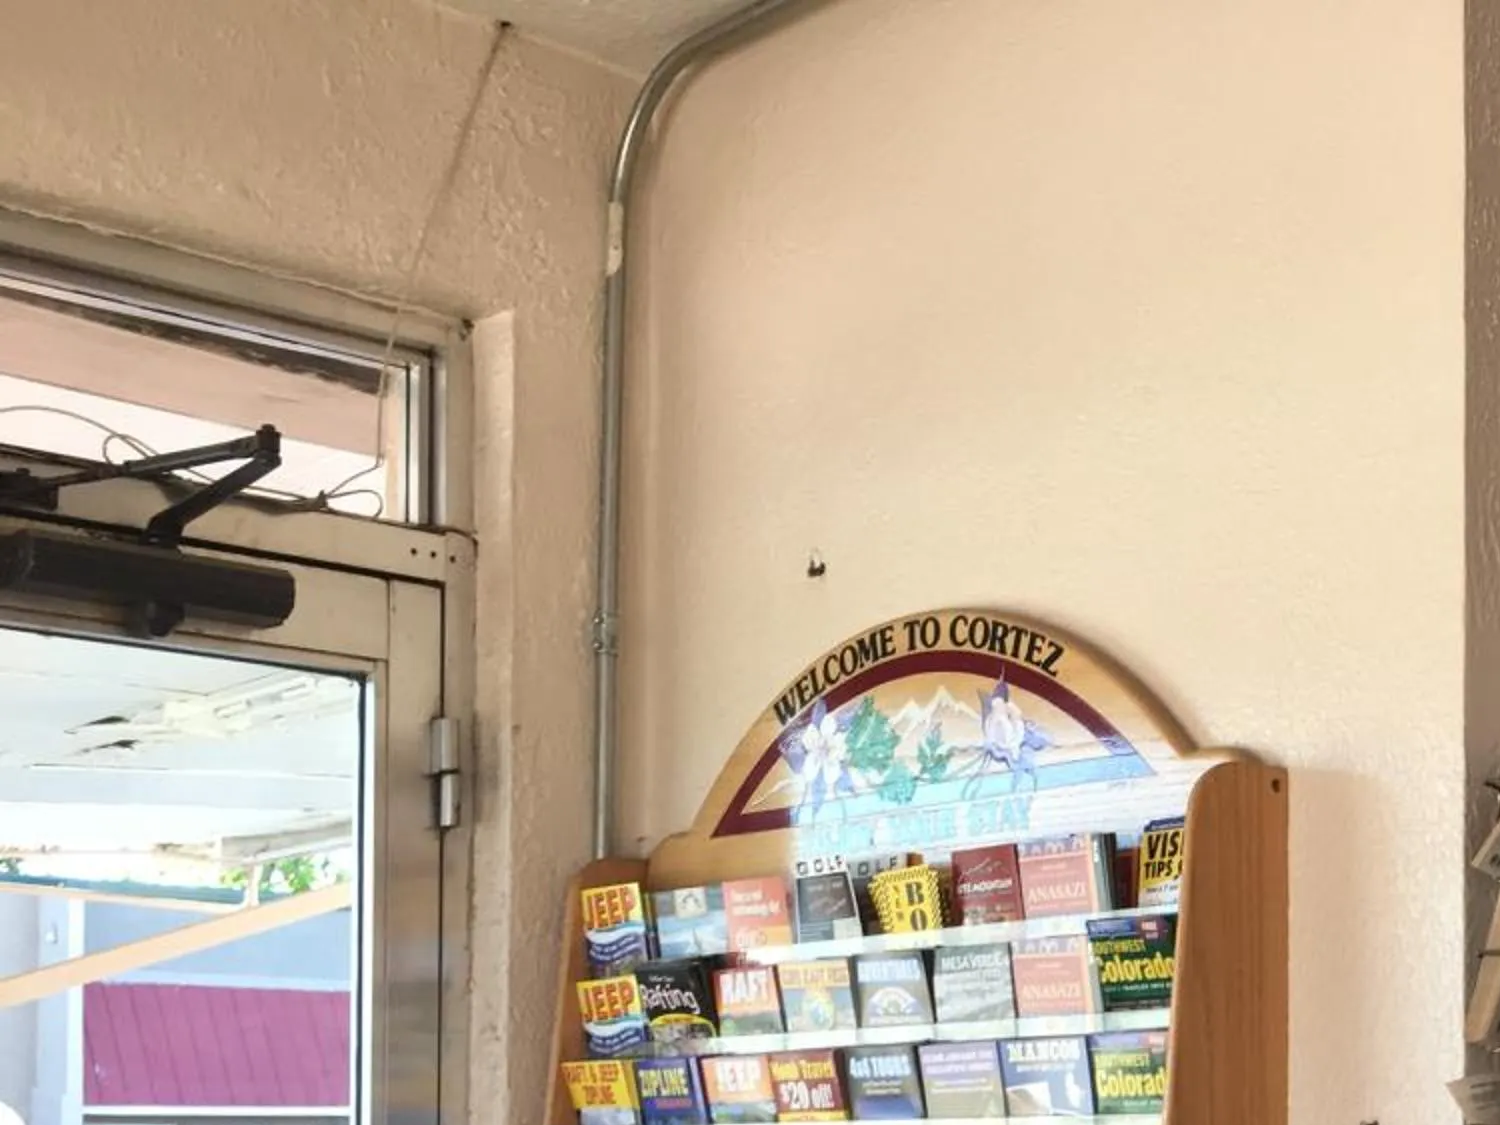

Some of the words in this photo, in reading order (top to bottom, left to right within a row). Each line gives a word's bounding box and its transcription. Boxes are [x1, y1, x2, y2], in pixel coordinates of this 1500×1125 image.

[773, 626, 895, 726] WELCOME
[904, 618, 939, 649] TO
[949, 616, 1064, 677] CORTEZ
[797, 855, 845, 876] GOLF
[1144, 860, 1173, 880] TIPS
[585, 886, 636, 930] JEEP
[579, 980, 636, 1022] JEEP
[638, 1067, 689, 1098] ZIPLINE
[781, 1080, 809, 1111] $20
[1096, 1067, 1164, 1098] Colorad
